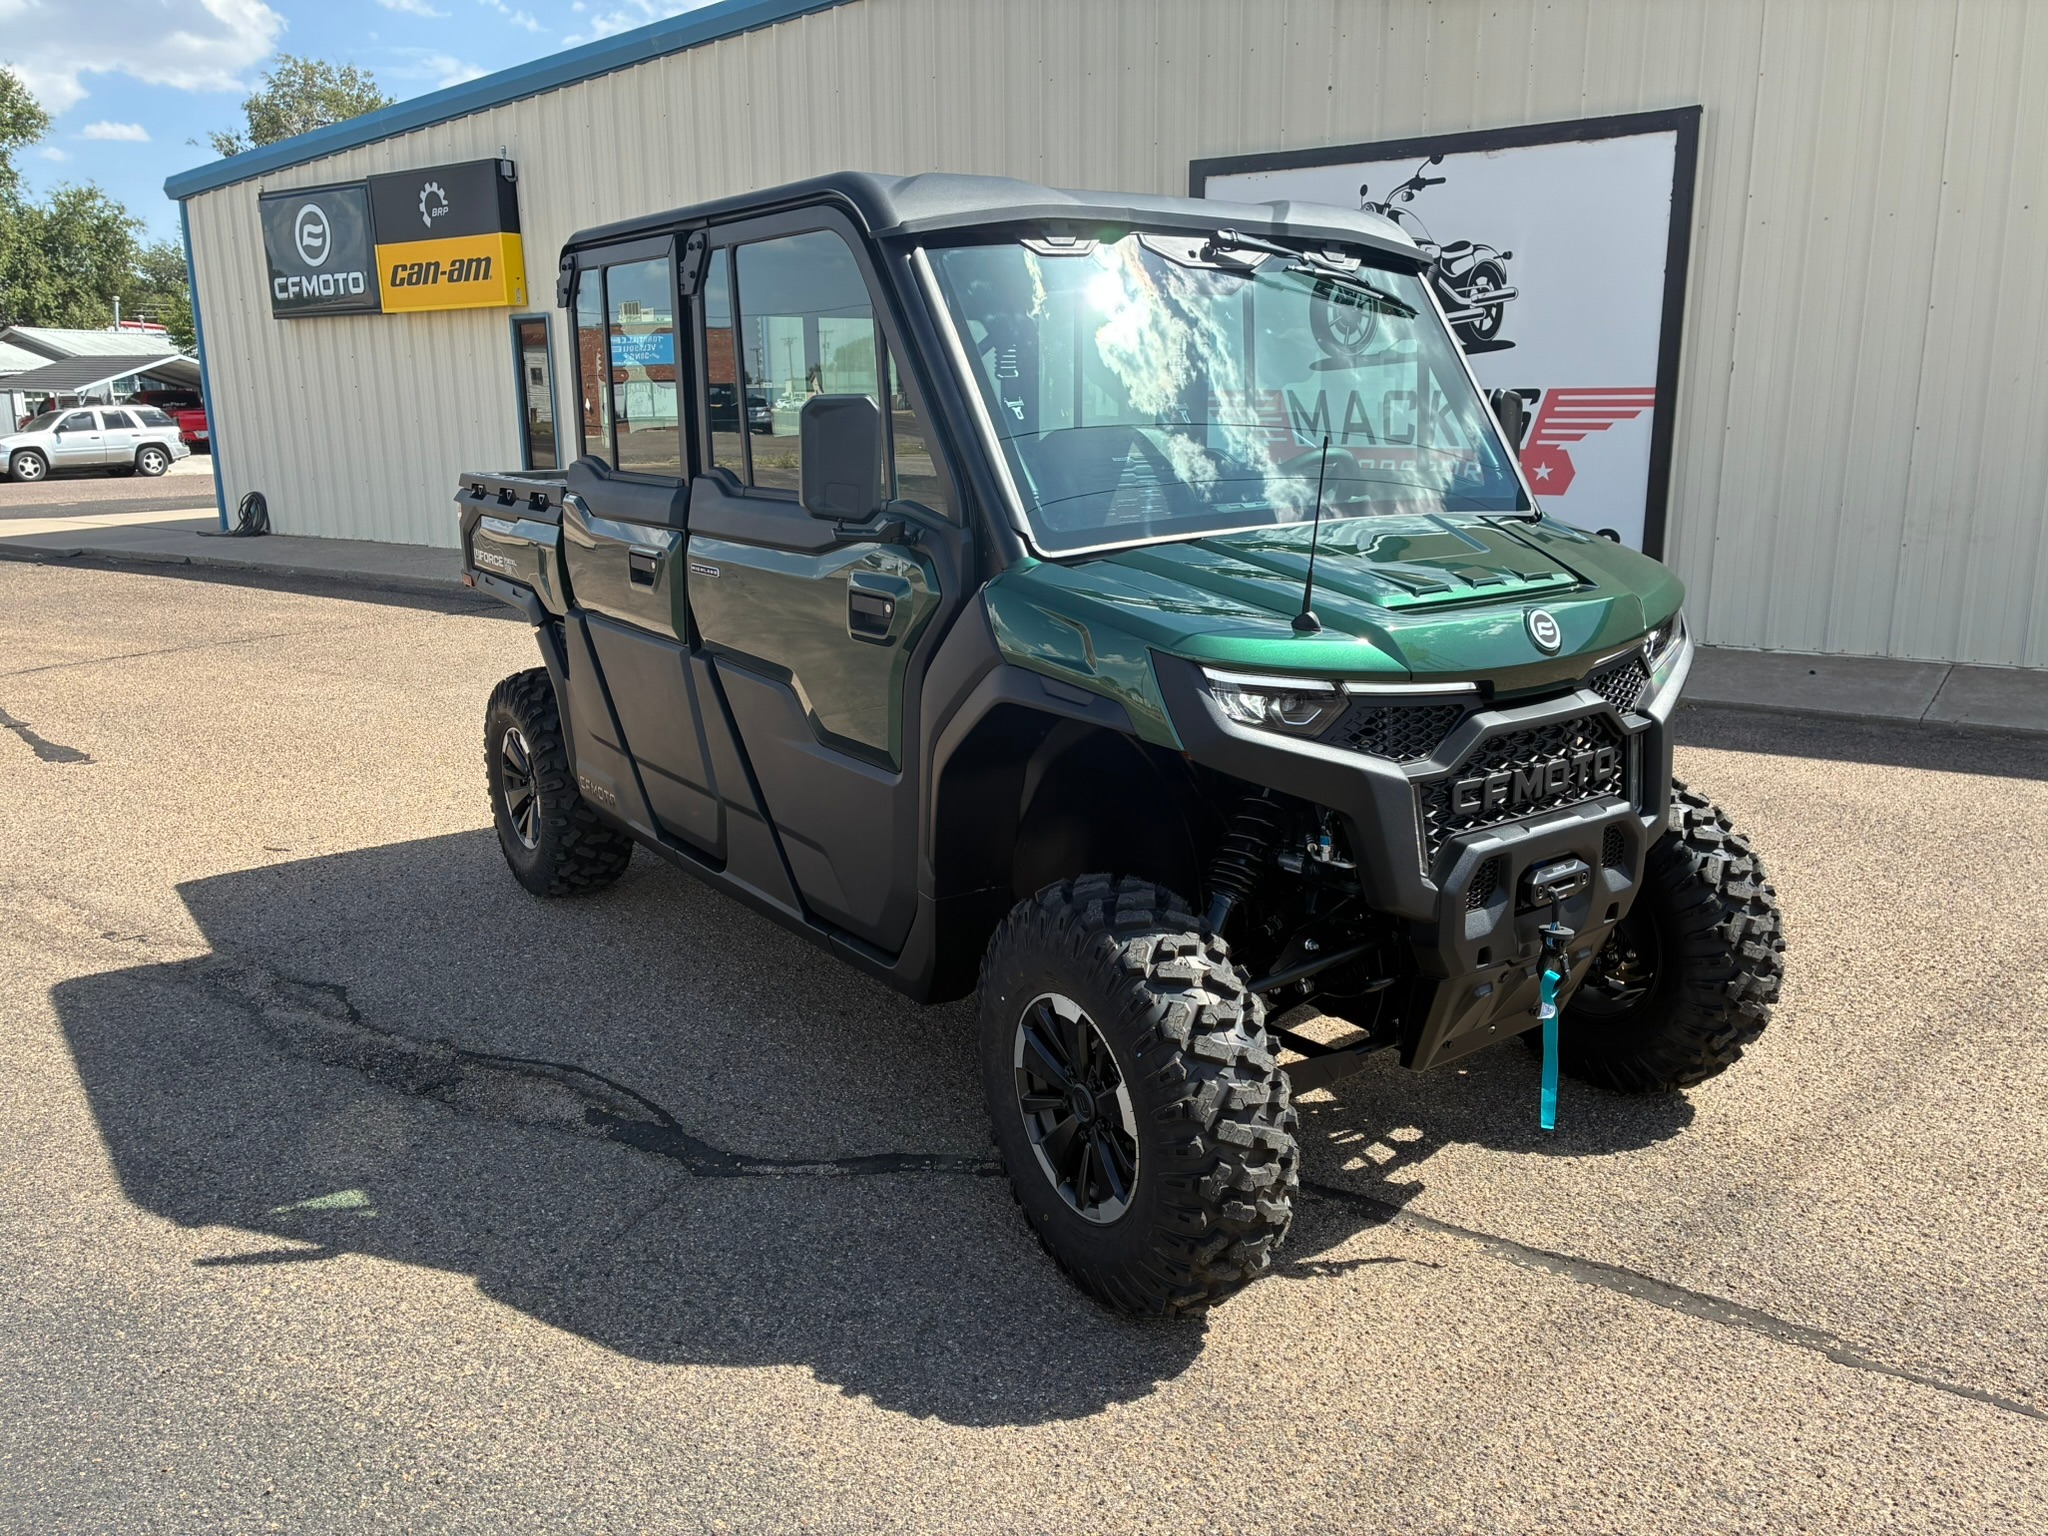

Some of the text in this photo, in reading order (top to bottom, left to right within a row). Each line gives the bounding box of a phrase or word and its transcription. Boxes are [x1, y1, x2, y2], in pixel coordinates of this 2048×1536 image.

[432, 206, 449, 217] BRP
[274, 271, 365, 299] CFMOTO
[390, 255, 492, 287] can-am
[579, 775, 616, 807] CFMOTO
[1451, 746, 1616, 815] CFMOTO
